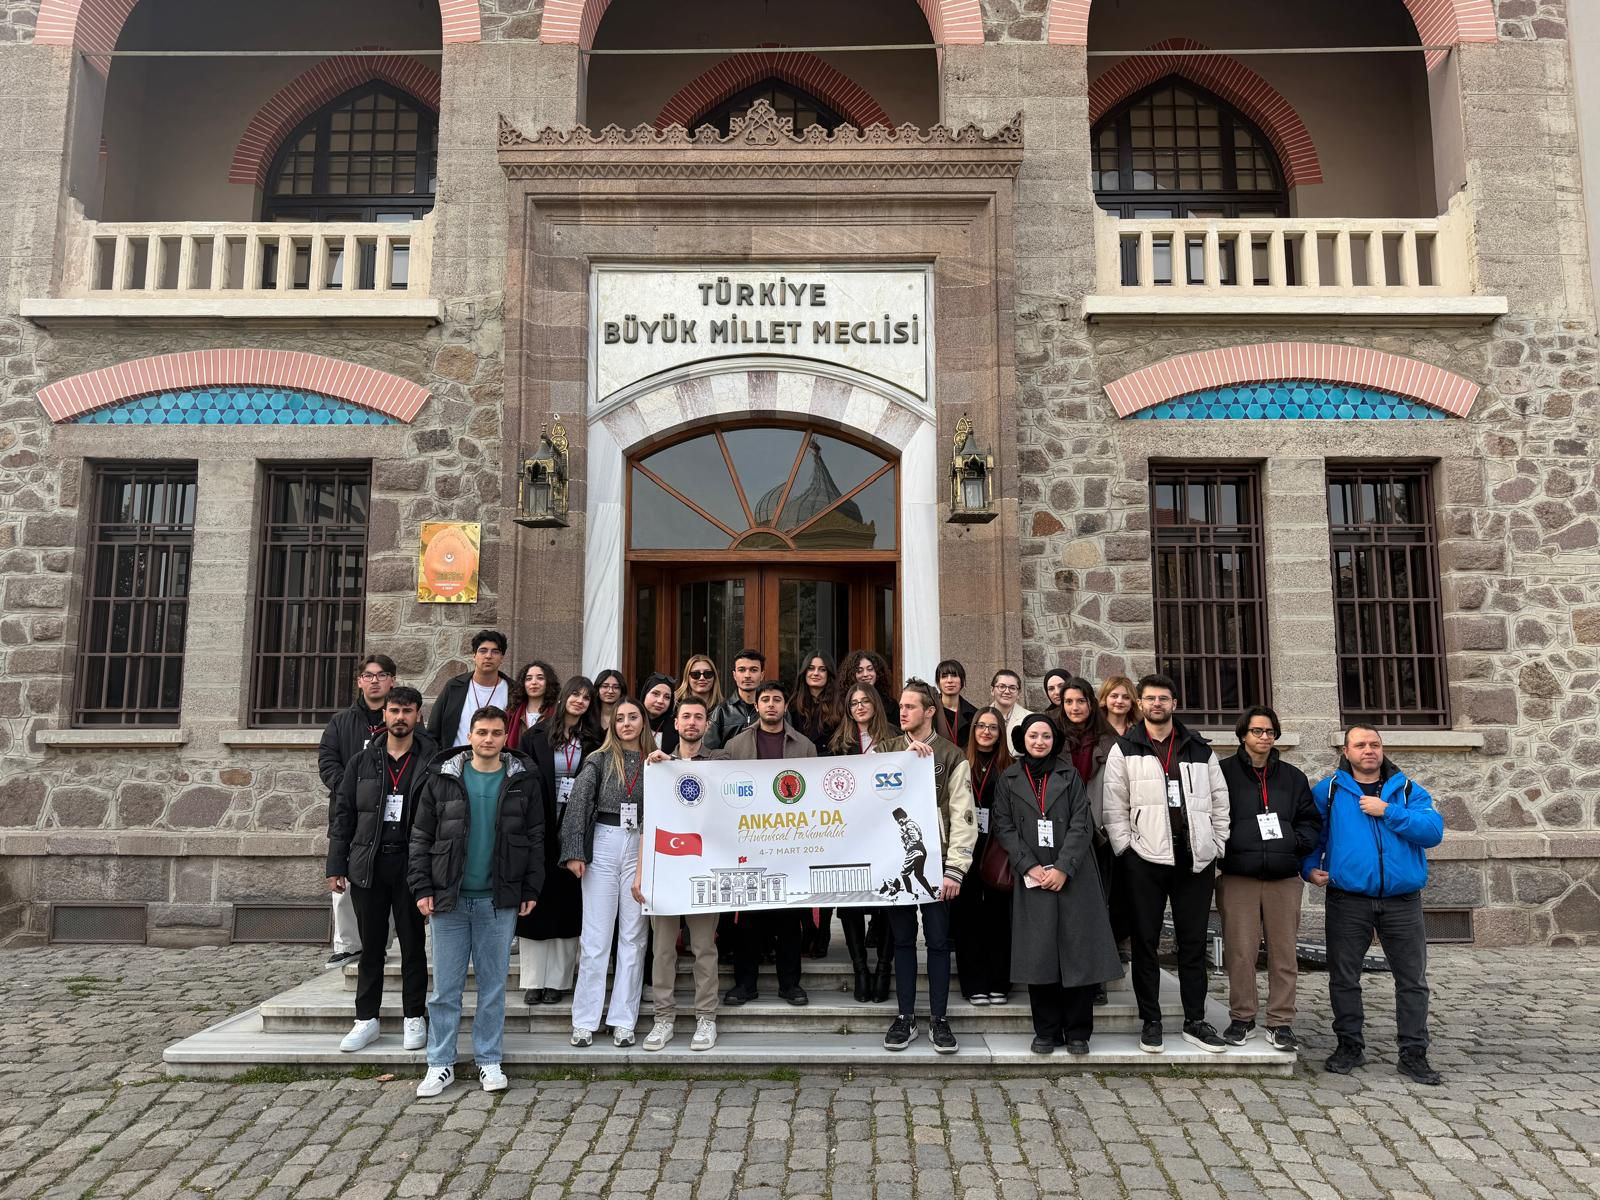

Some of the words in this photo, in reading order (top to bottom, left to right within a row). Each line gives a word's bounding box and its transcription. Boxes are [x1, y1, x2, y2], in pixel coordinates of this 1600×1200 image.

[698, 276, 826, 306] TÜRKİYE
[604, 313, 697, 345] BÜYÜK
[710, 313, 801, 344] MİLLET
[812, 313, 919, 344] MECLİSİ
[875, 772, 903, 787] SKS
[759, 848, 774, 856] 4-7
[776, 846, 801, 855] MART
[803, 845, 825, 854] 2026
